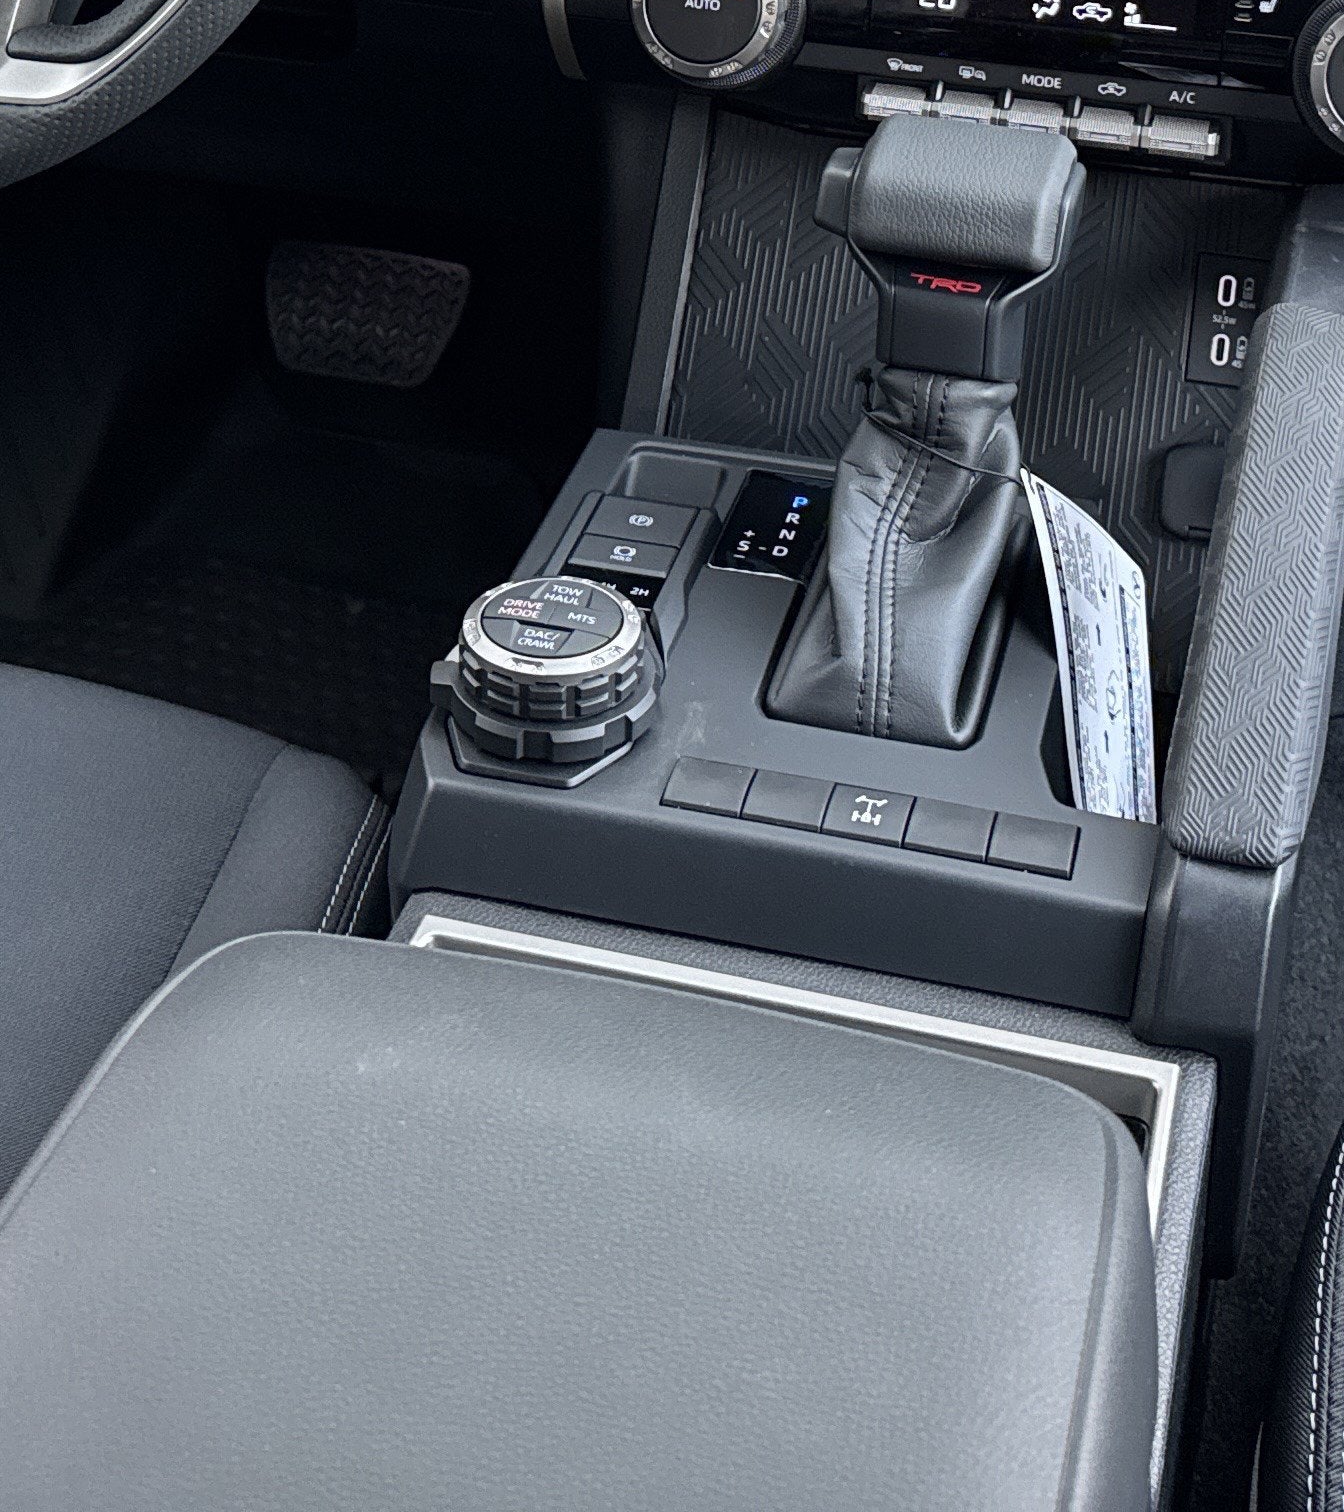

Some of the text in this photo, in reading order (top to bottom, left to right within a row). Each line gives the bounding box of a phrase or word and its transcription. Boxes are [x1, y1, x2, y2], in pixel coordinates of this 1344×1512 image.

[1021, 73, 1062, 89] MODE
[1169, 90, 1196, 104] A/C
[910, 272, 982, 293] TRD
[791, 496, 809, 508] P
[785, 512, 800, 525] R
[778, 528, 797, 541] N
[736, 540, 789, 557] S D
[552, 584, 584, 597] TOW
[629, 586, 650, 597] 2H
[503, 598, 544, 611] DRIVE
[543, 593, 580, 606] HAUL
[497, 606, 541, 619] MODE
[567, 612, 598, 626] MTS
[524, 628, 561, 641] DAC/
[517, 638, 556, 650] CRAWL
